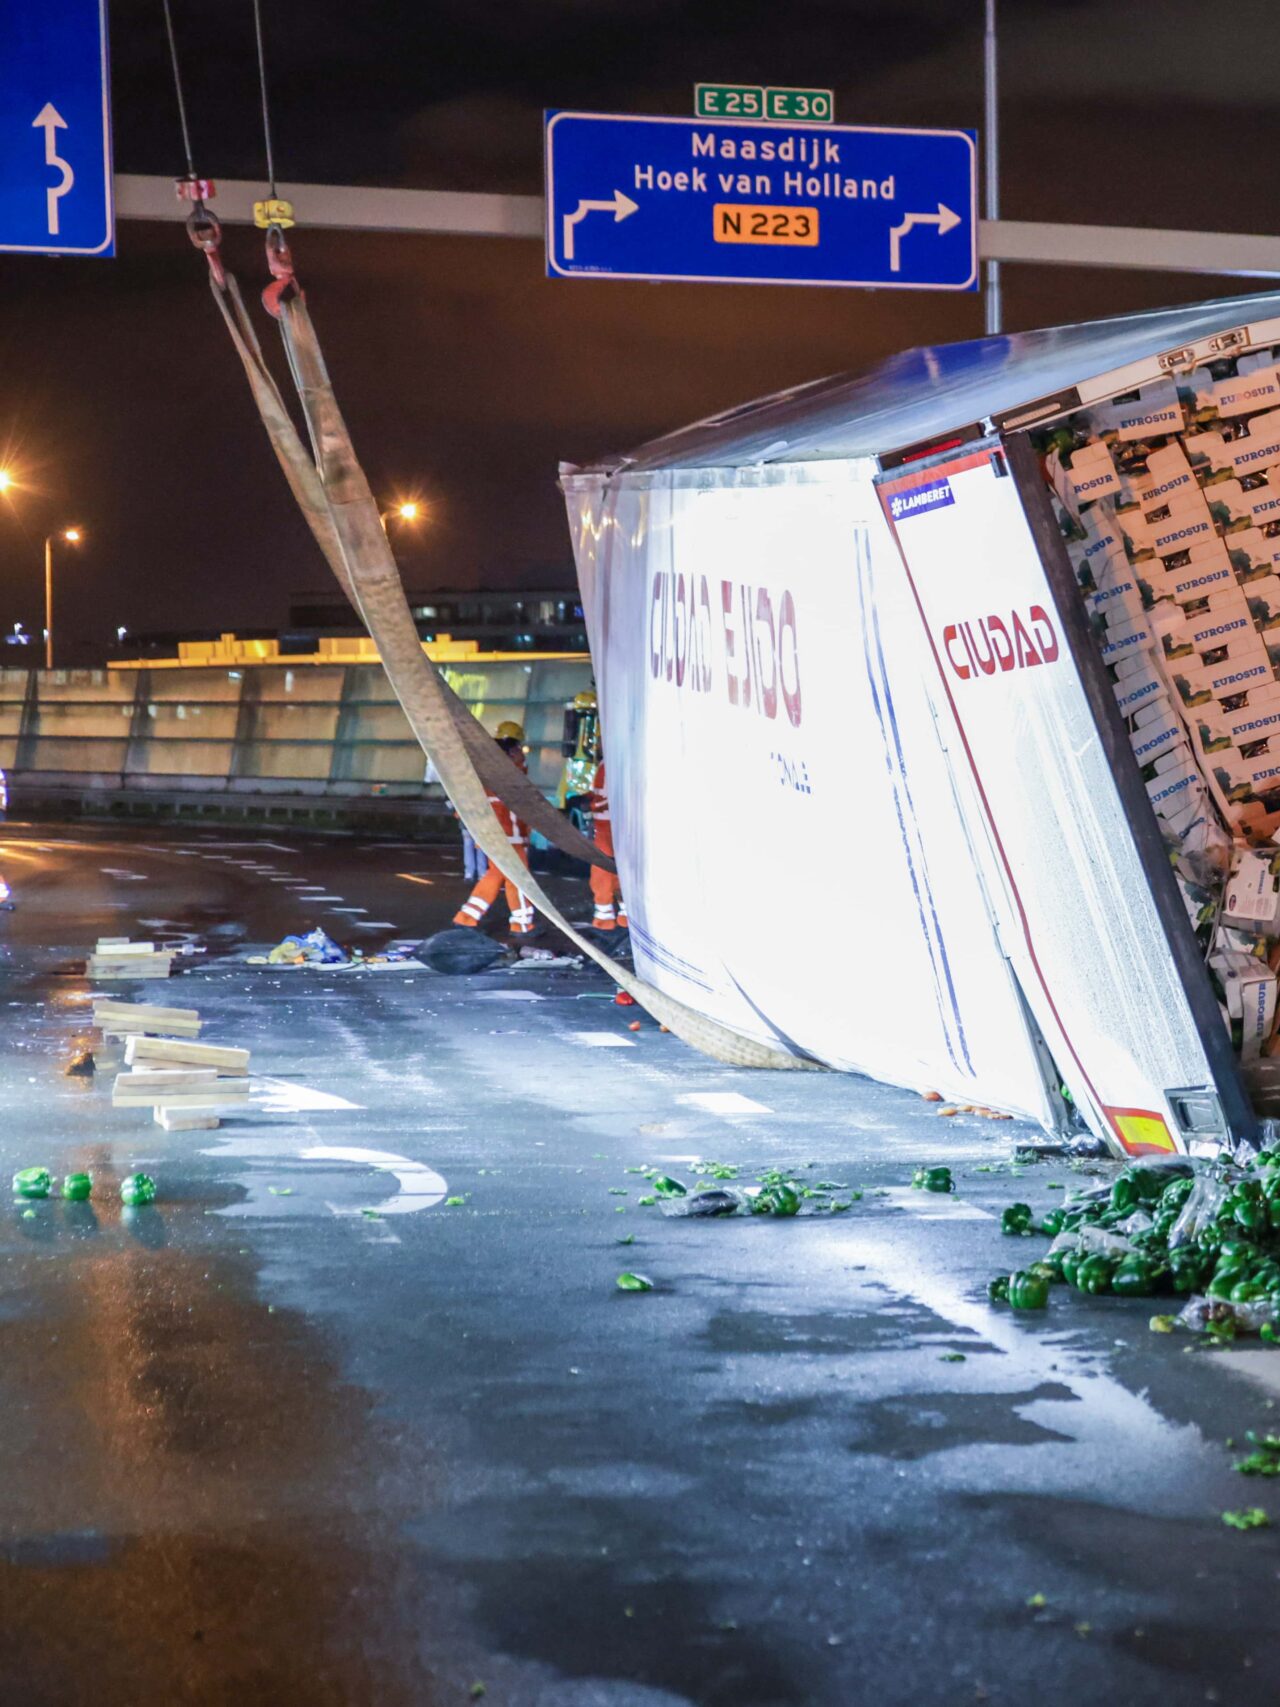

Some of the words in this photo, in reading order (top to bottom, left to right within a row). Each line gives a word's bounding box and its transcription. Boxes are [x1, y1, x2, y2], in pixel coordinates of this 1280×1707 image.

[704, 92, 719, 112] E
[725, 93, 759, 113] 25
[773, 95, 788, 114] E
[794, 96, 829, 117] 30
[691, 132, 841, 170] Maasdijk
[633, 164, 707, 192] Hoek
[718, 174, 771, 195] van
[784, 172, 896, 200] Holland
[722, 213, 741, 235] N
[750, 213, 811, 237] 223
[1220, 385, 1276, 406] EUROSUR
[1120, 410, 1177, 429] EUROSUR
[1073, 474, 1114, 494] ROSUR
[1141, 474, 1190, 501] EUROSUR
[902, 485, 951, 511] LAMBERET
[1085, 535, 1115, 558] OSUR
[1155, 522, 1209, 547] EUROSUR
[1175, 569, 1230, 593] EUROSUR
[1194, 618, 1248, 642] EUROSUR
[943, 605, 1060, 681] CIUDAD
[1102, 631, 1148, 655] UROSUR
[1212, 665, 1267, 689] EUROSUR
[1135, 727, 1179, 756] UROSUR
